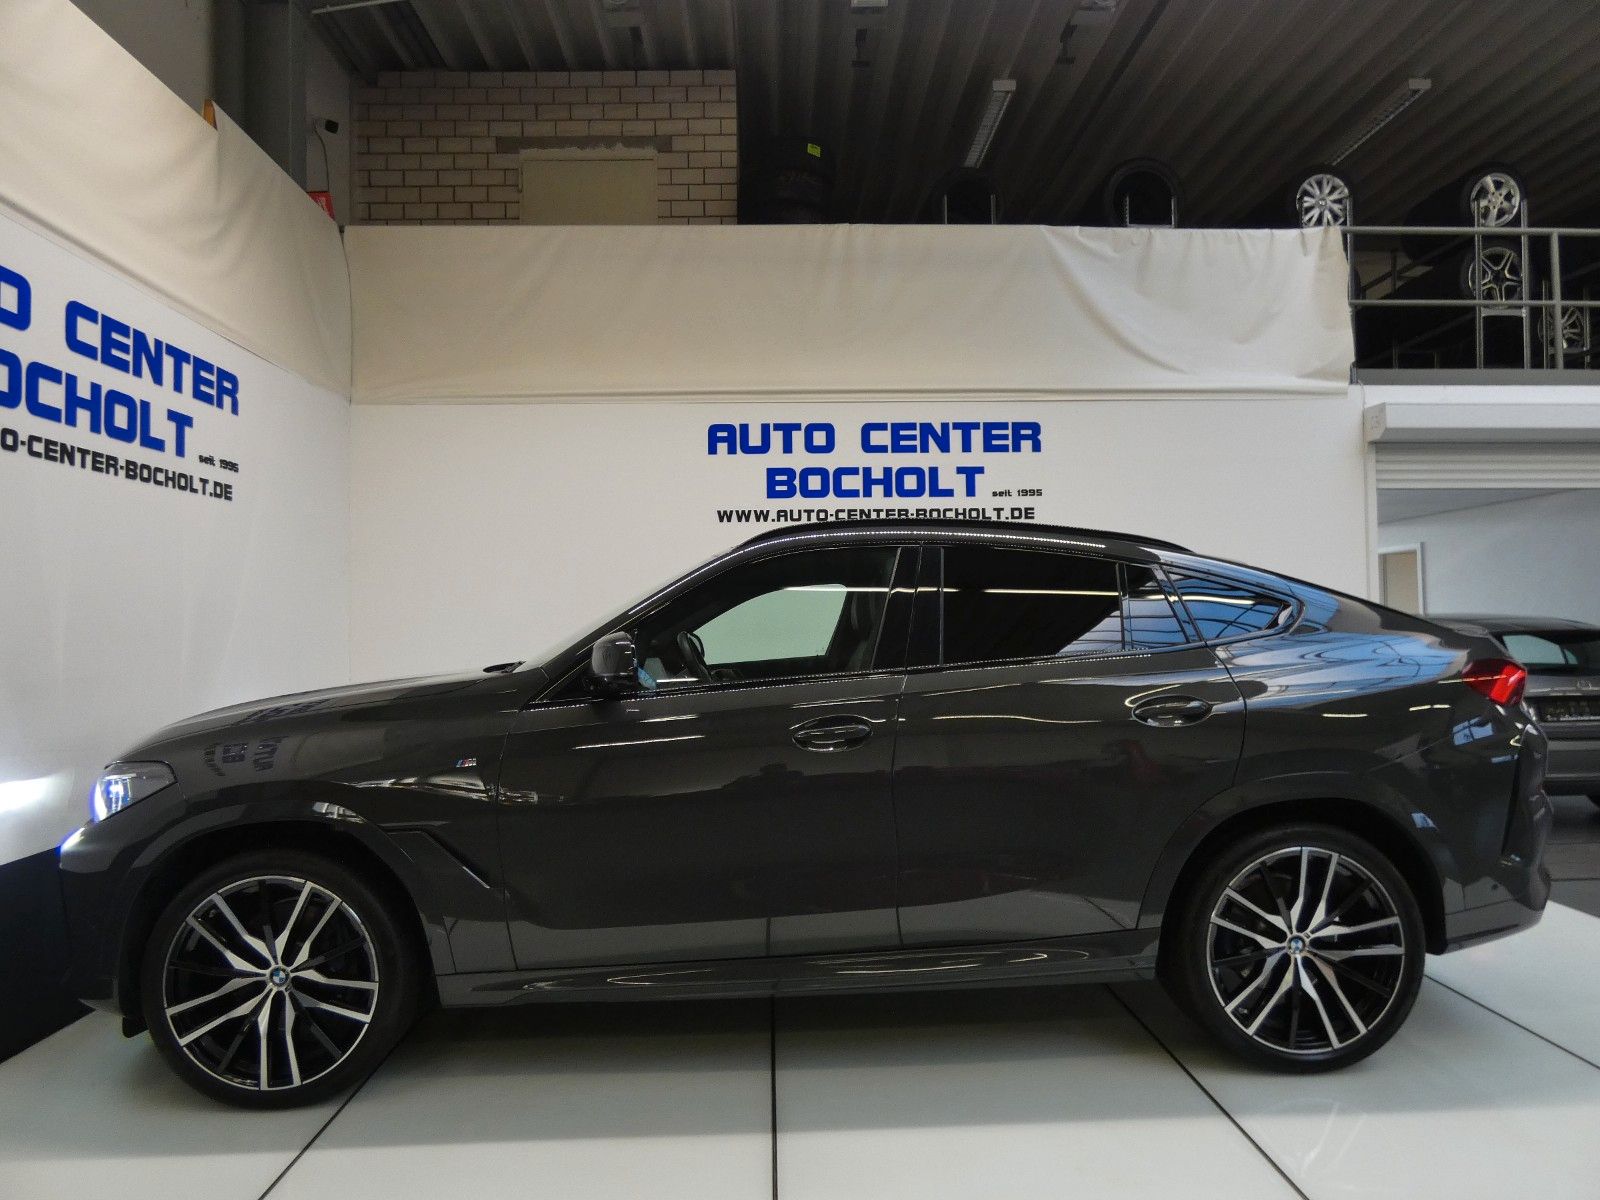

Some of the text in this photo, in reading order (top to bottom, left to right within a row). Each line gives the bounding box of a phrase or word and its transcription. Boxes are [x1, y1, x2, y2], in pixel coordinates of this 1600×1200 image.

[65, 300, 240, 416] CENTER
[708, 421, 1042, 455] AUTO CENTER
[199, 454, 216, 467] seit
[219, 459, 240, 473] 1995
[766, 466, 1043, 499] BOCHOLT seit 1995
[717, 507, 1035, 523] WWW.AUTO-CENTER-BOCHOLT.DE
